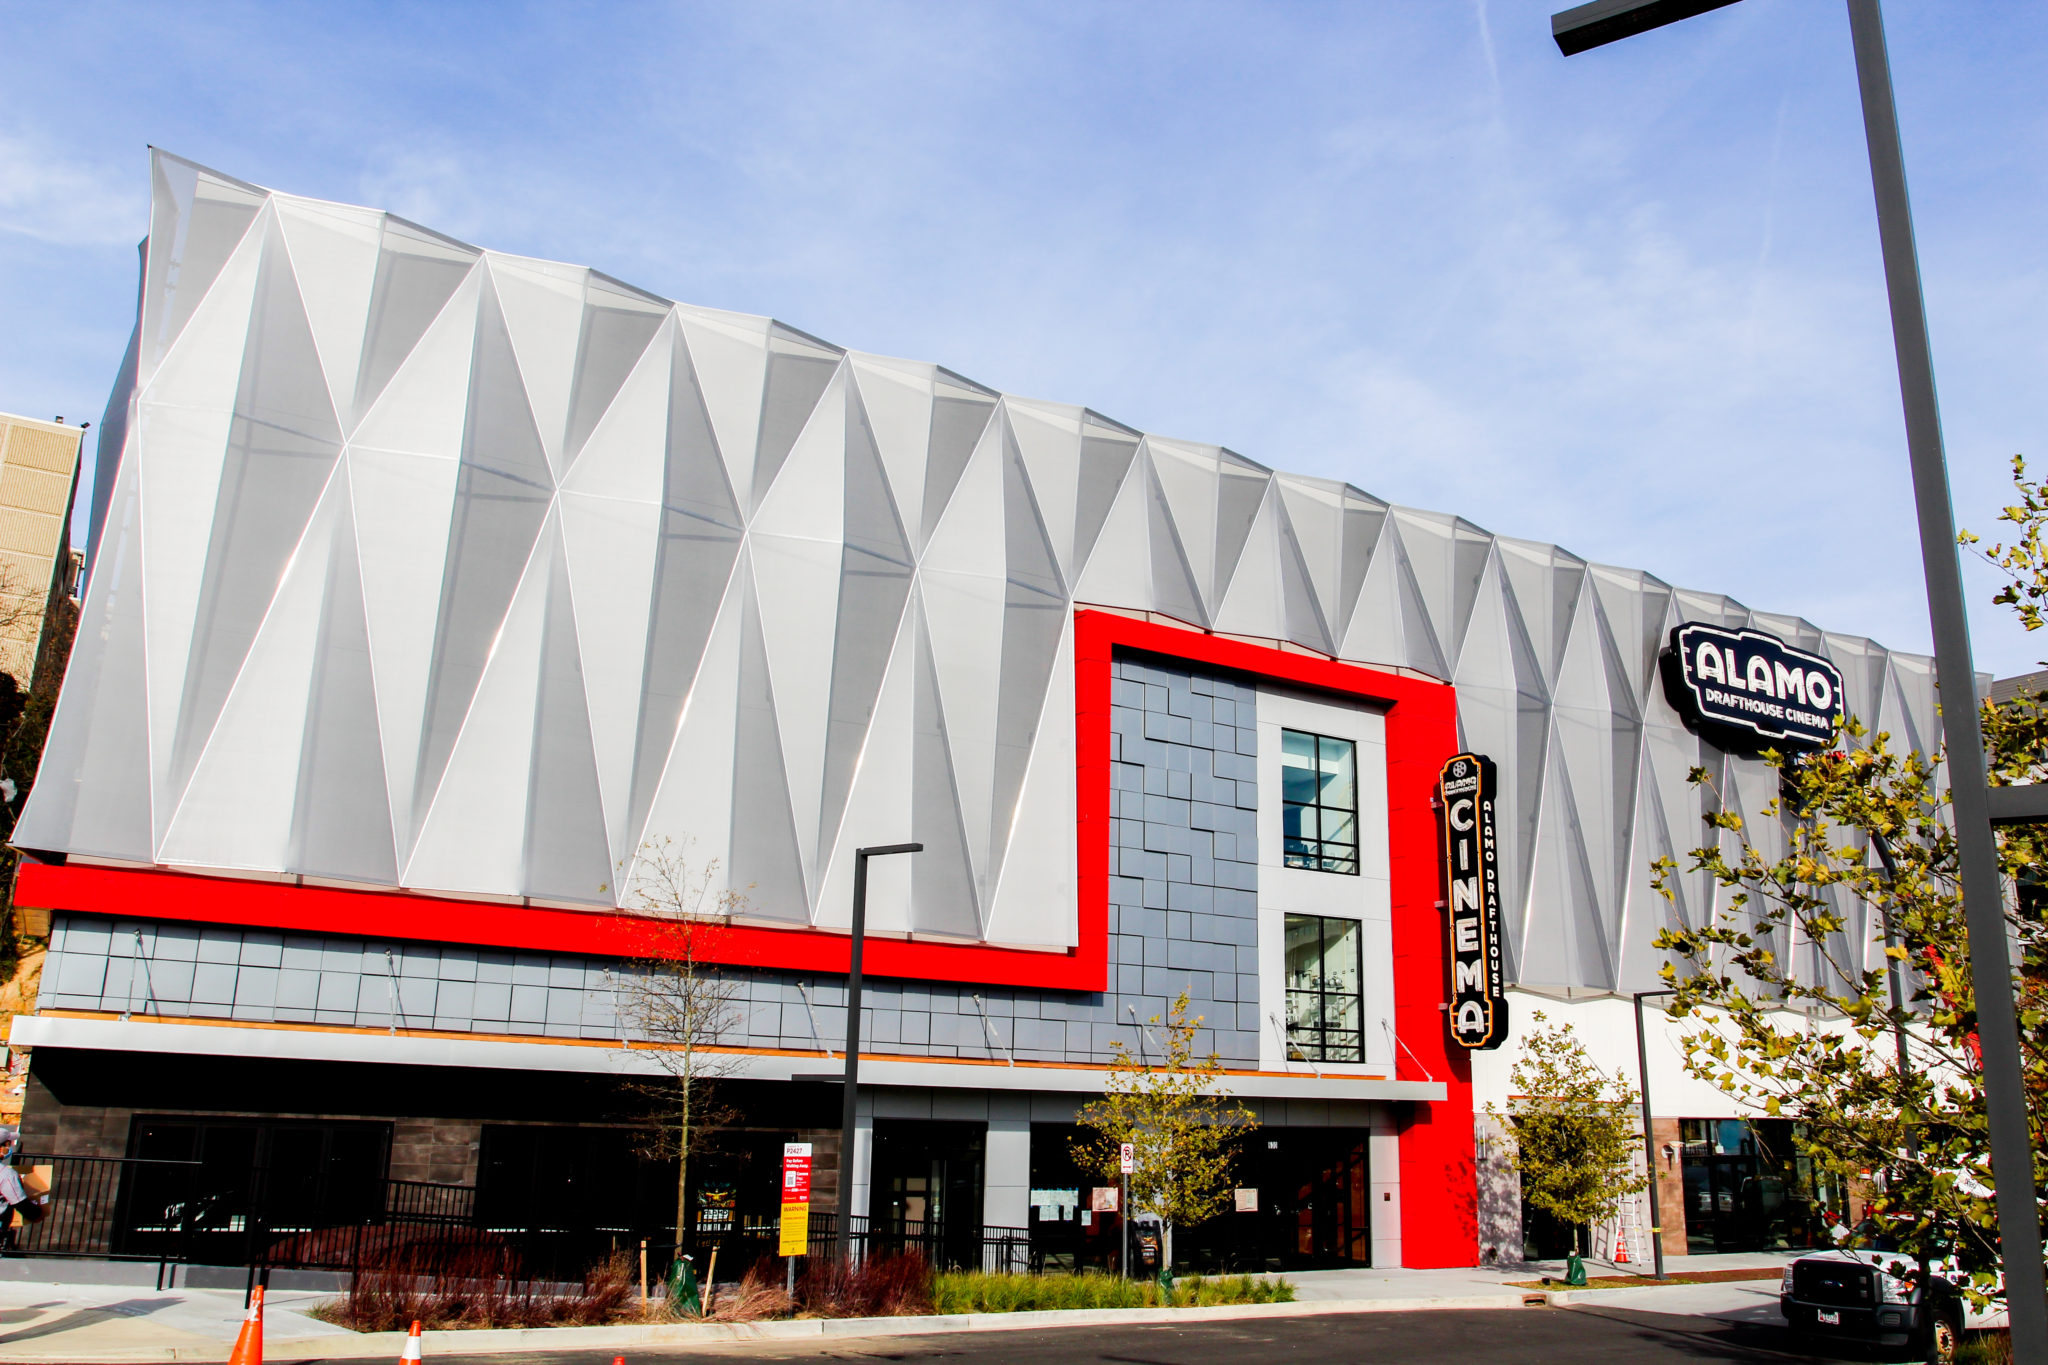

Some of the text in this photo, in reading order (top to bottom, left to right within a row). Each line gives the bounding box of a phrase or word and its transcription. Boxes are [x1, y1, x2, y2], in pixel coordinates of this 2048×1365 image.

[1696, 641, 1832, 710] ALAMO
[1705, 688, 1830, 730] DRAFTHOUSE CINEMA
[1444, 776, 1476, 790] ALAMO
[1449, 799, 1485, 1034] CINEMA
[1483, 801, 1500, 998] ALAMO DRAFTHOUSE
